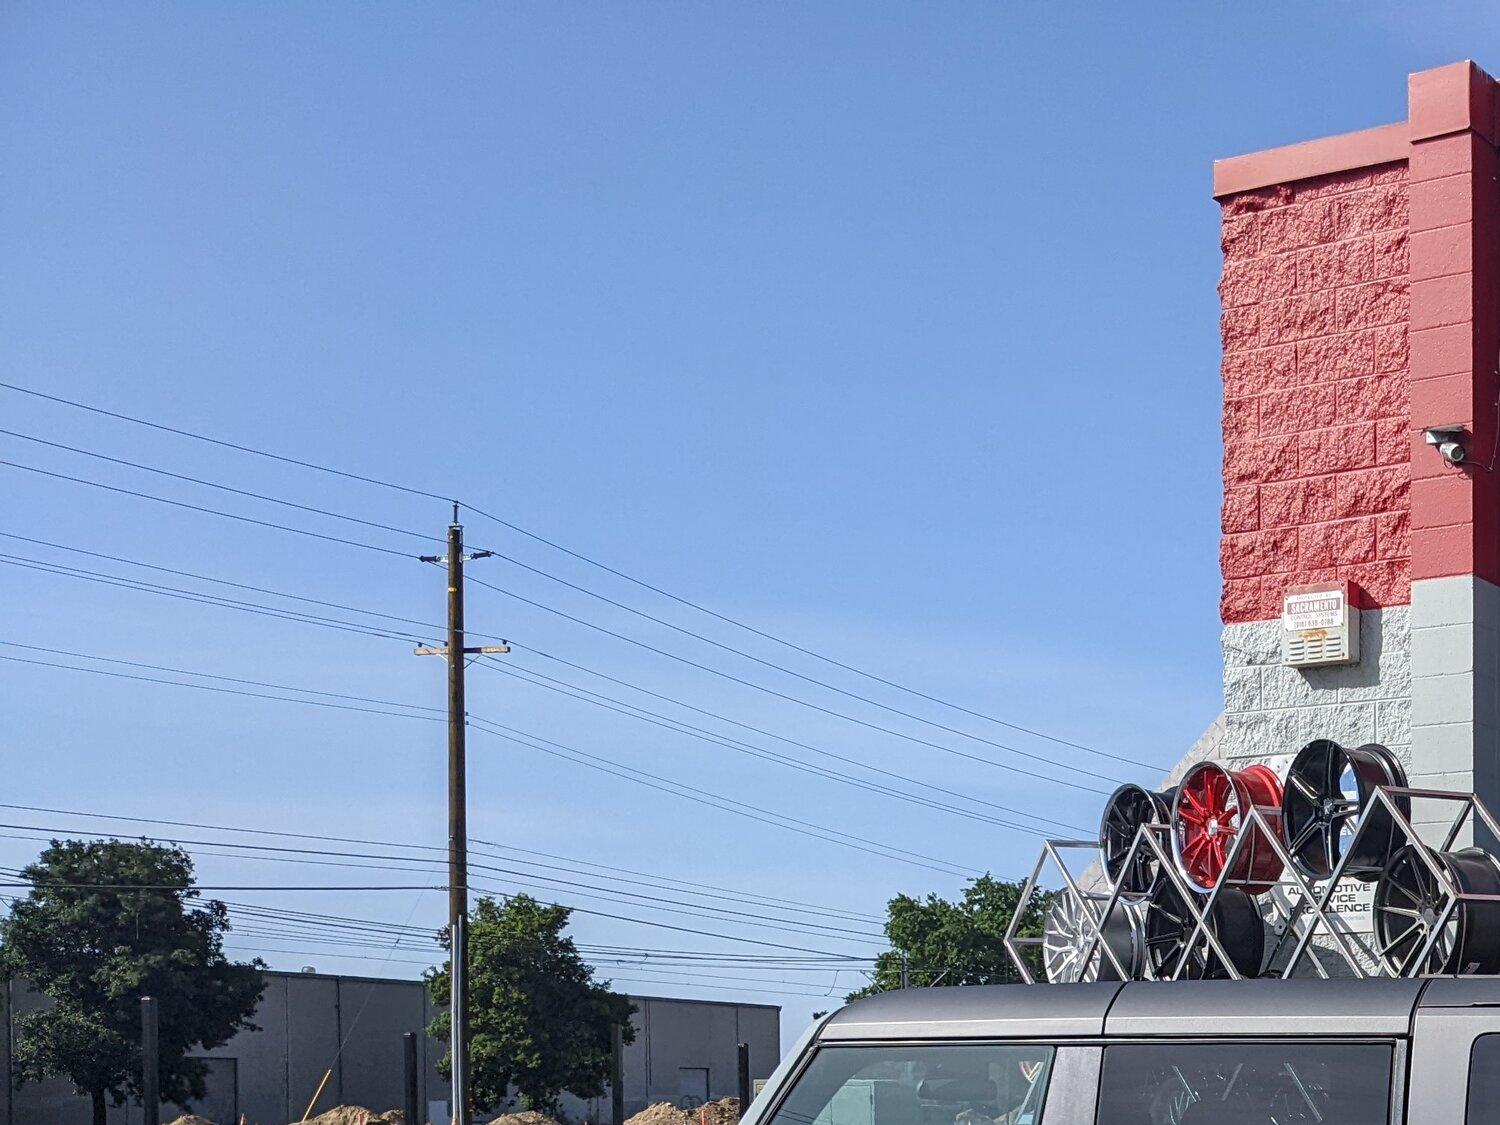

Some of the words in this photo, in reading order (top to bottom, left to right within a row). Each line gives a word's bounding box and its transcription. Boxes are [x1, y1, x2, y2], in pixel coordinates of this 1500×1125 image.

[1290, 599, 1337, 614] SACRAMENTO
[1315, 610, 1338, 618] SYSTEMS
[1288, 883, 1371, 896] AUOMOTIVE
